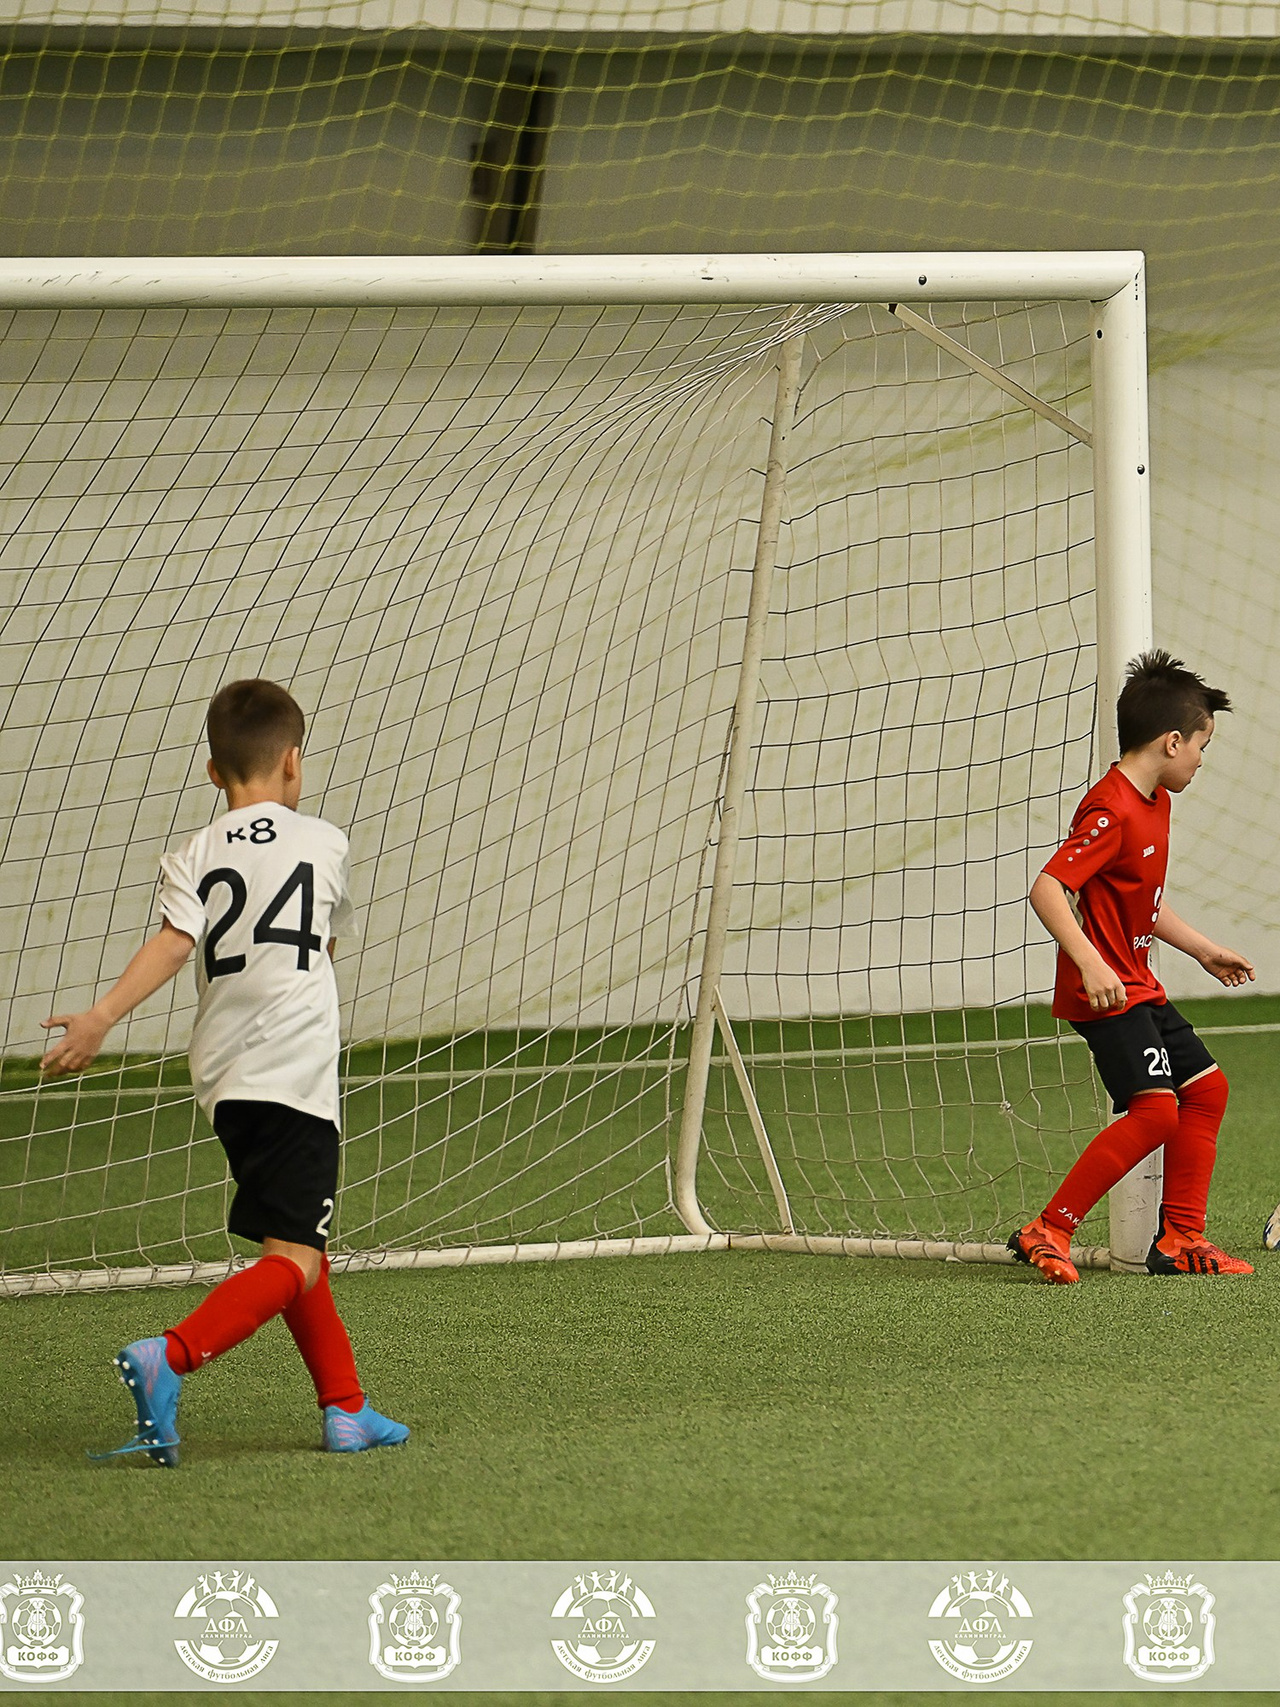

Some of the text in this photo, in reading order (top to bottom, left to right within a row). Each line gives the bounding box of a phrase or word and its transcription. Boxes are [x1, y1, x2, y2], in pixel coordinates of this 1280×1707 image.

[196, 860, 321, 984] 24
[1143, 1047, 1172, 1077] 28
[1058, 1207, 1081, 1226] JAK
